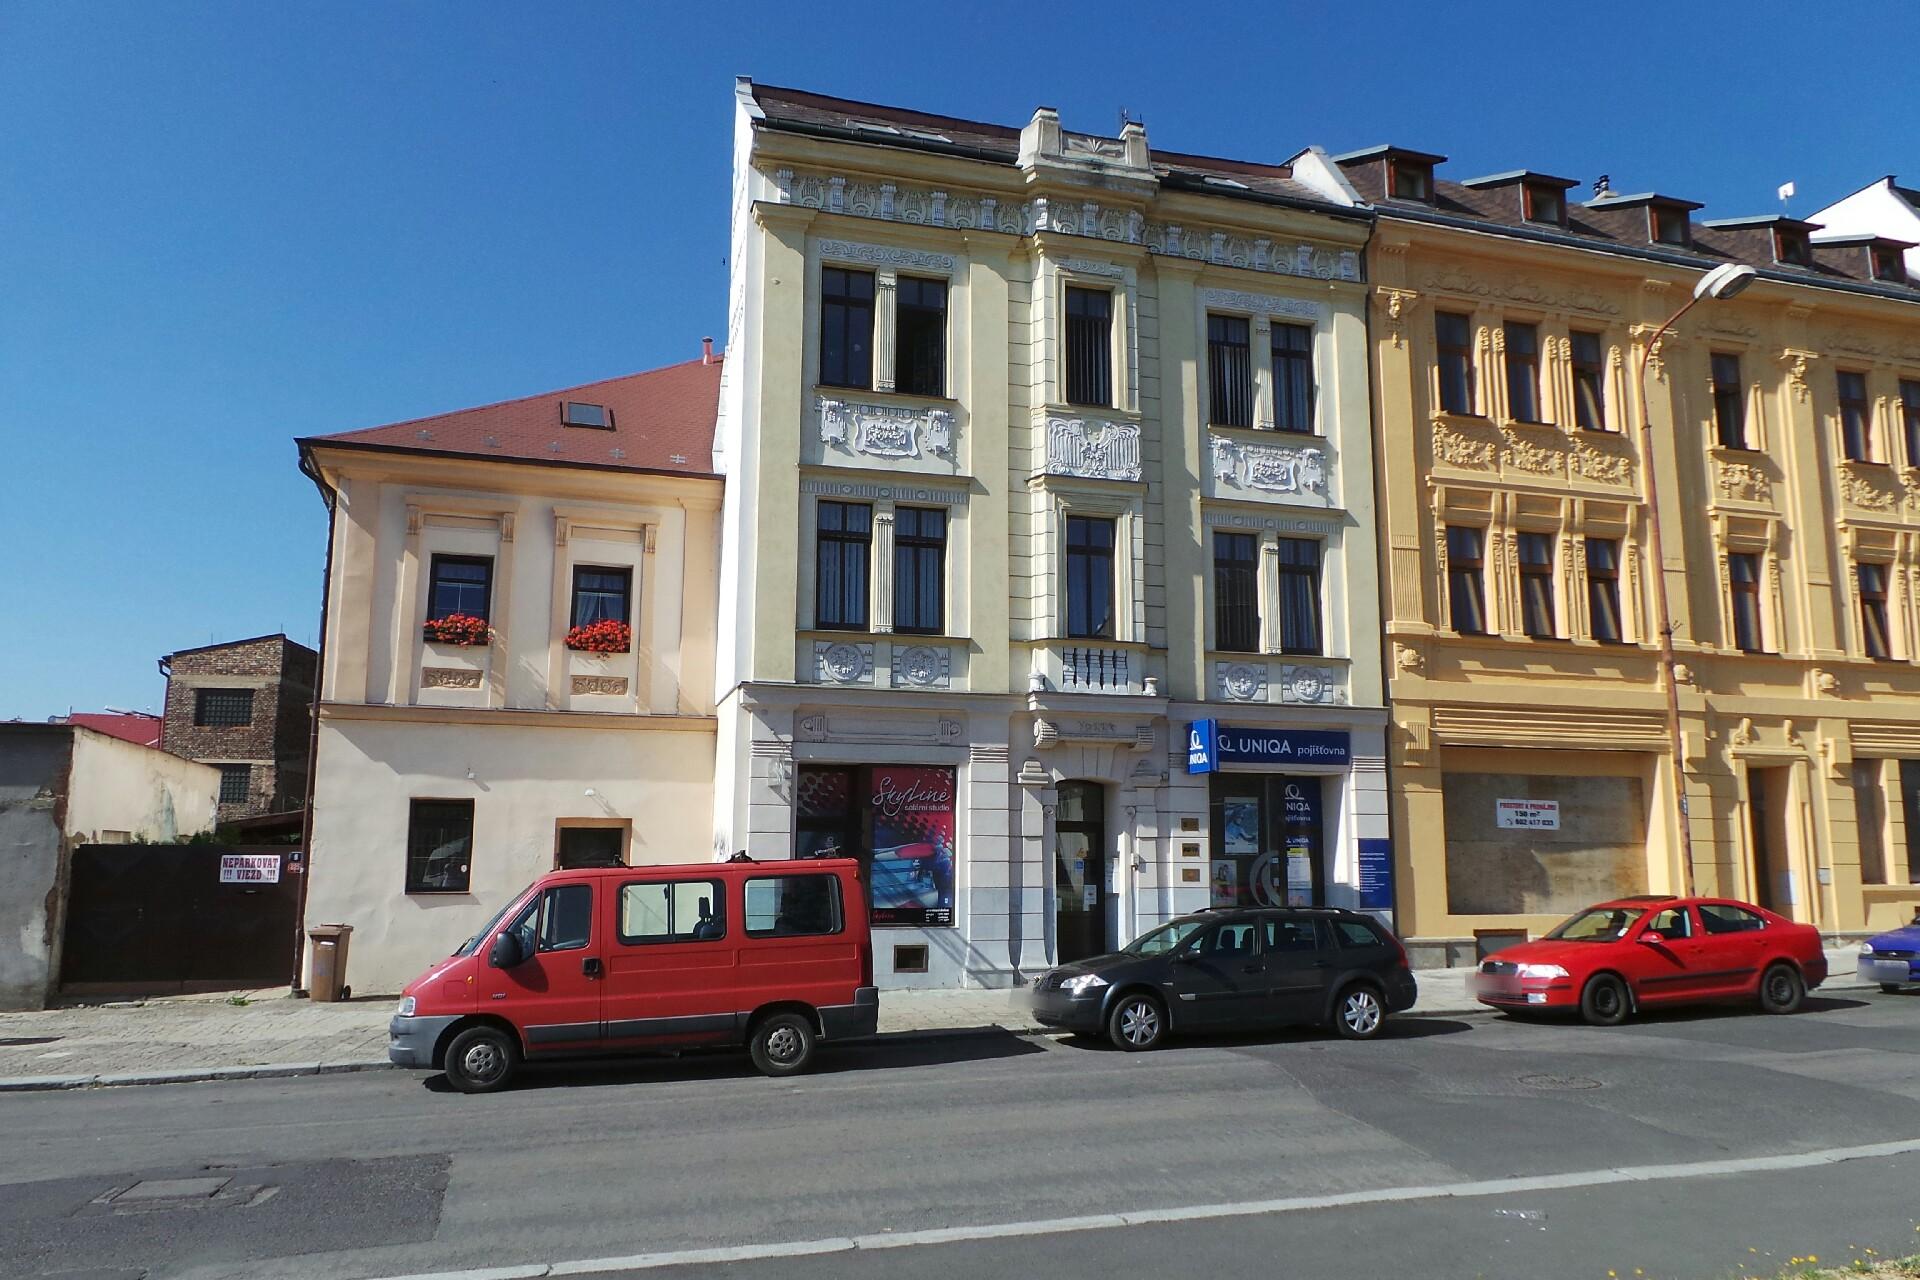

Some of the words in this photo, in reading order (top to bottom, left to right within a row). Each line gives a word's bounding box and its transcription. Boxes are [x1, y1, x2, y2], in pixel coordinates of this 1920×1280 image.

[1239, 738, 1292, 754] UNIQA
[1298, 744, 1345, 757] pojišťovna
[872, 776, 950, 816] Skyline
[928, 803, 950, 811] studio
[222, 857, 278, 868] NEPARKOVAT
[236, 869, 262, 880] VJEZD
